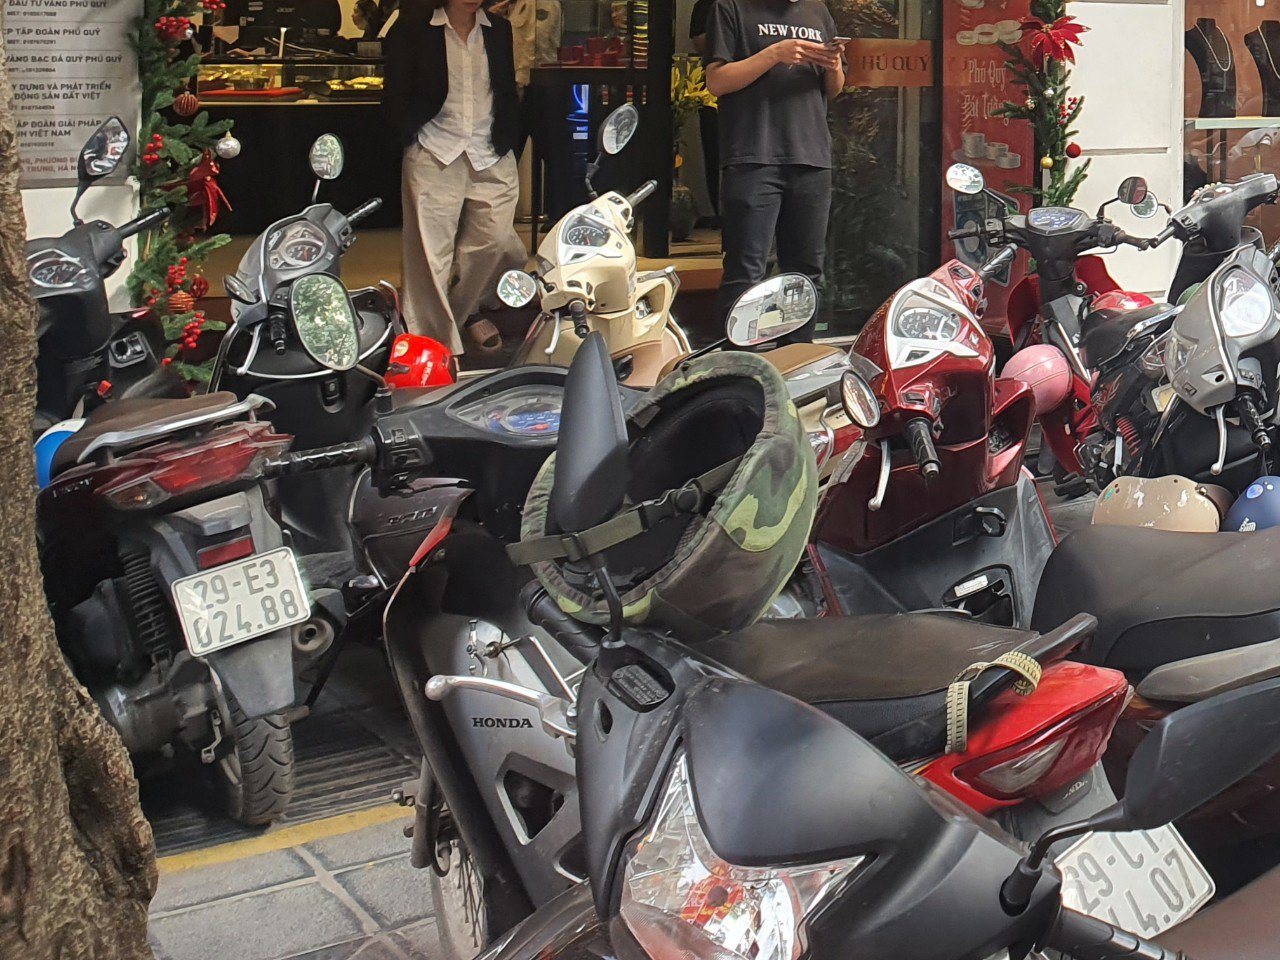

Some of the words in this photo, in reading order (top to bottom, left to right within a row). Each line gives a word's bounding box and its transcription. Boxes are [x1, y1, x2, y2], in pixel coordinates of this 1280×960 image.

[758, 22, 790, 38] NEW
[791, 25, 822, 41] YORK
[861, 53, 888, 71] HÚ
[193, 559, 279, 610] 29-E3
[193, 590, 299, 648] 024.88
[472, 717, 534, 729] HONDA
